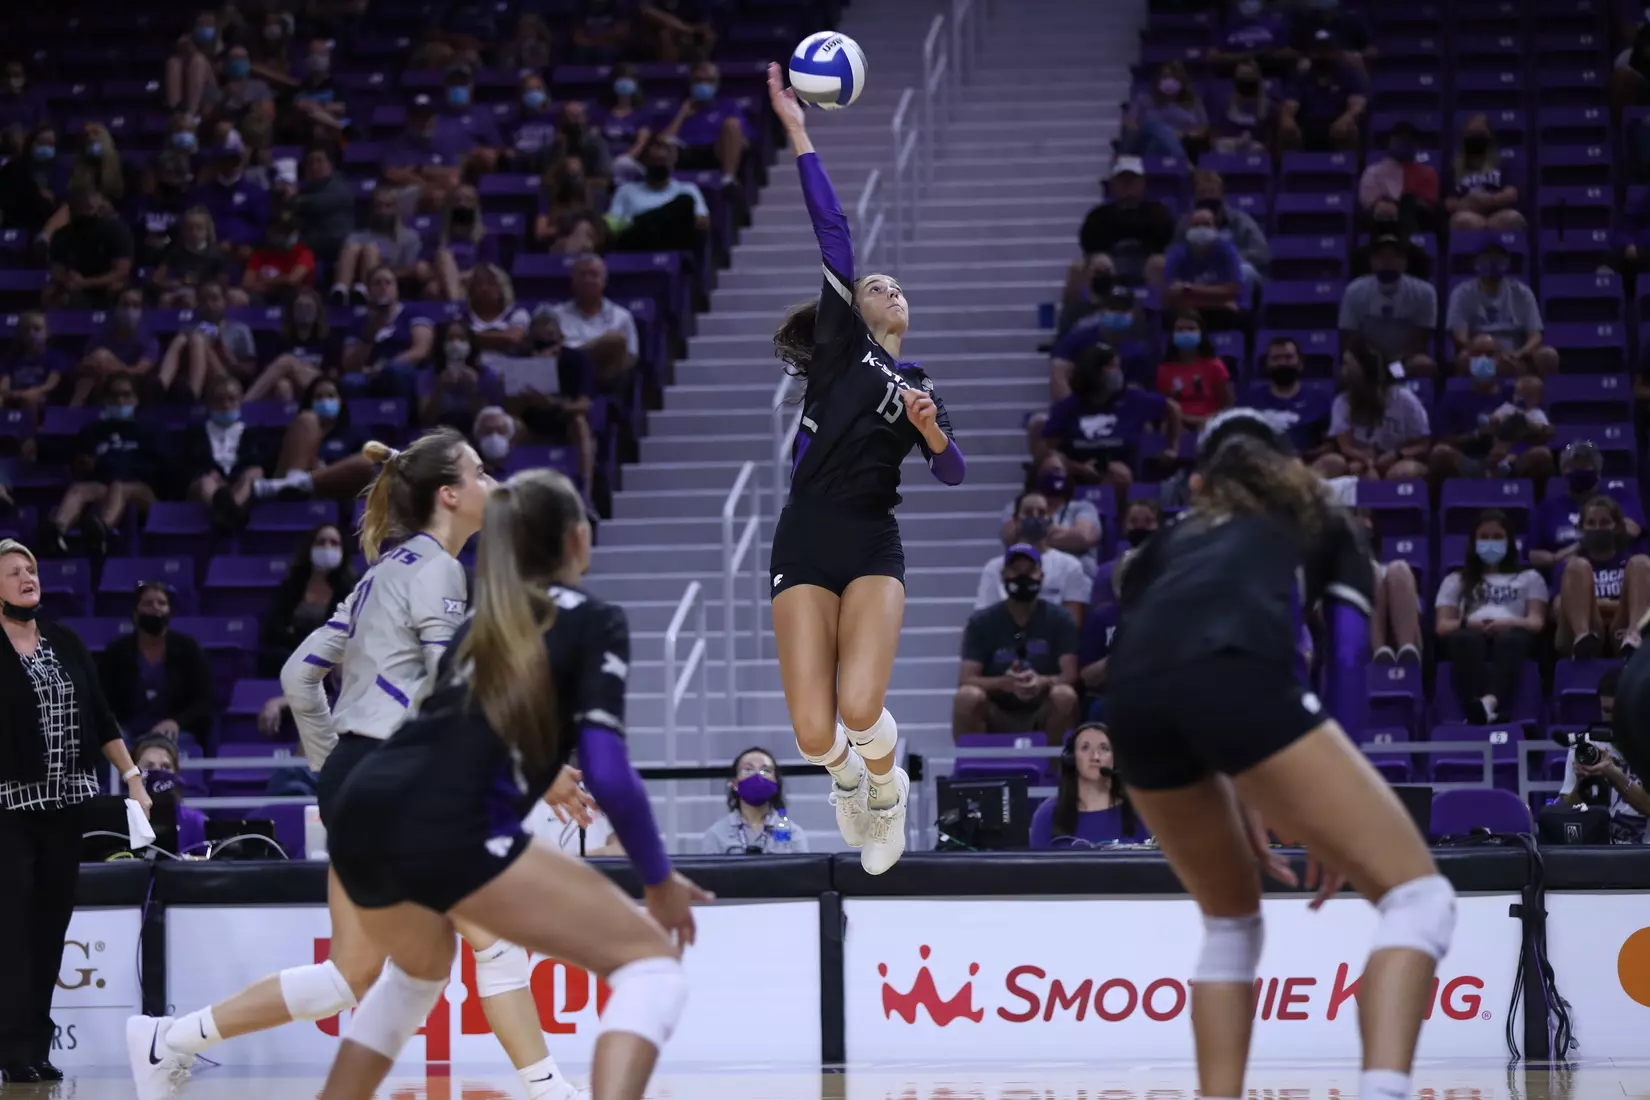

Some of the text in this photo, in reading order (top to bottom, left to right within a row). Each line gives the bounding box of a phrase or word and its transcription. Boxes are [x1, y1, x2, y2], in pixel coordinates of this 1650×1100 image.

[876, 381, 904, 424] 15
[997, 962, 1485, 1022] SMOOIE KG
